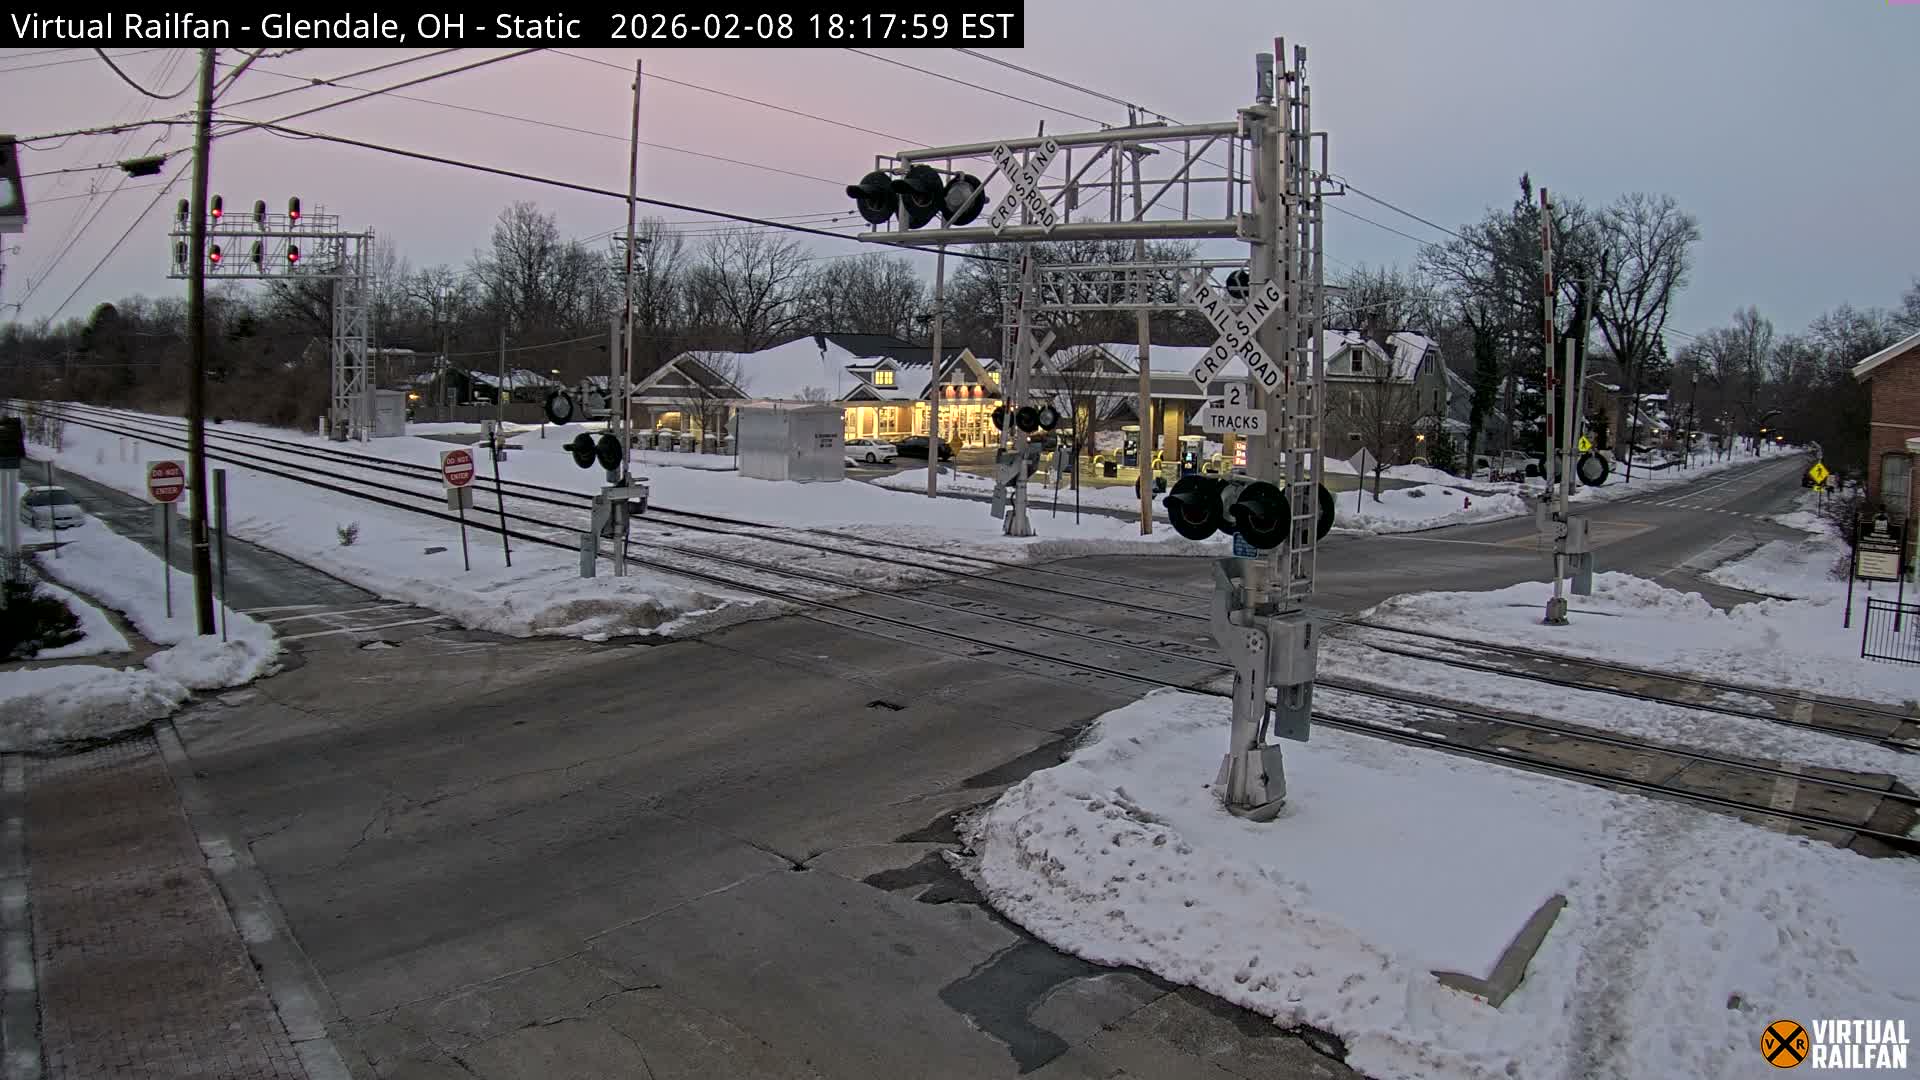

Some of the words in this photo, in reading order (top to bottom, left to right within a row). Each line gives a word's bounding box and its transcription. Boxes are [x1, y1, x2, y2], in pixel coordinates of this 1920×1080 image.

[991, 141, 1056, 229] CROSSING
[1194, 286, 1280, 384] CROSSING
[1230, 388, 1240, 405] 2
[1210, 415, 1258, 429] TRACKS
[450, 471, 469, 481] ENTER
